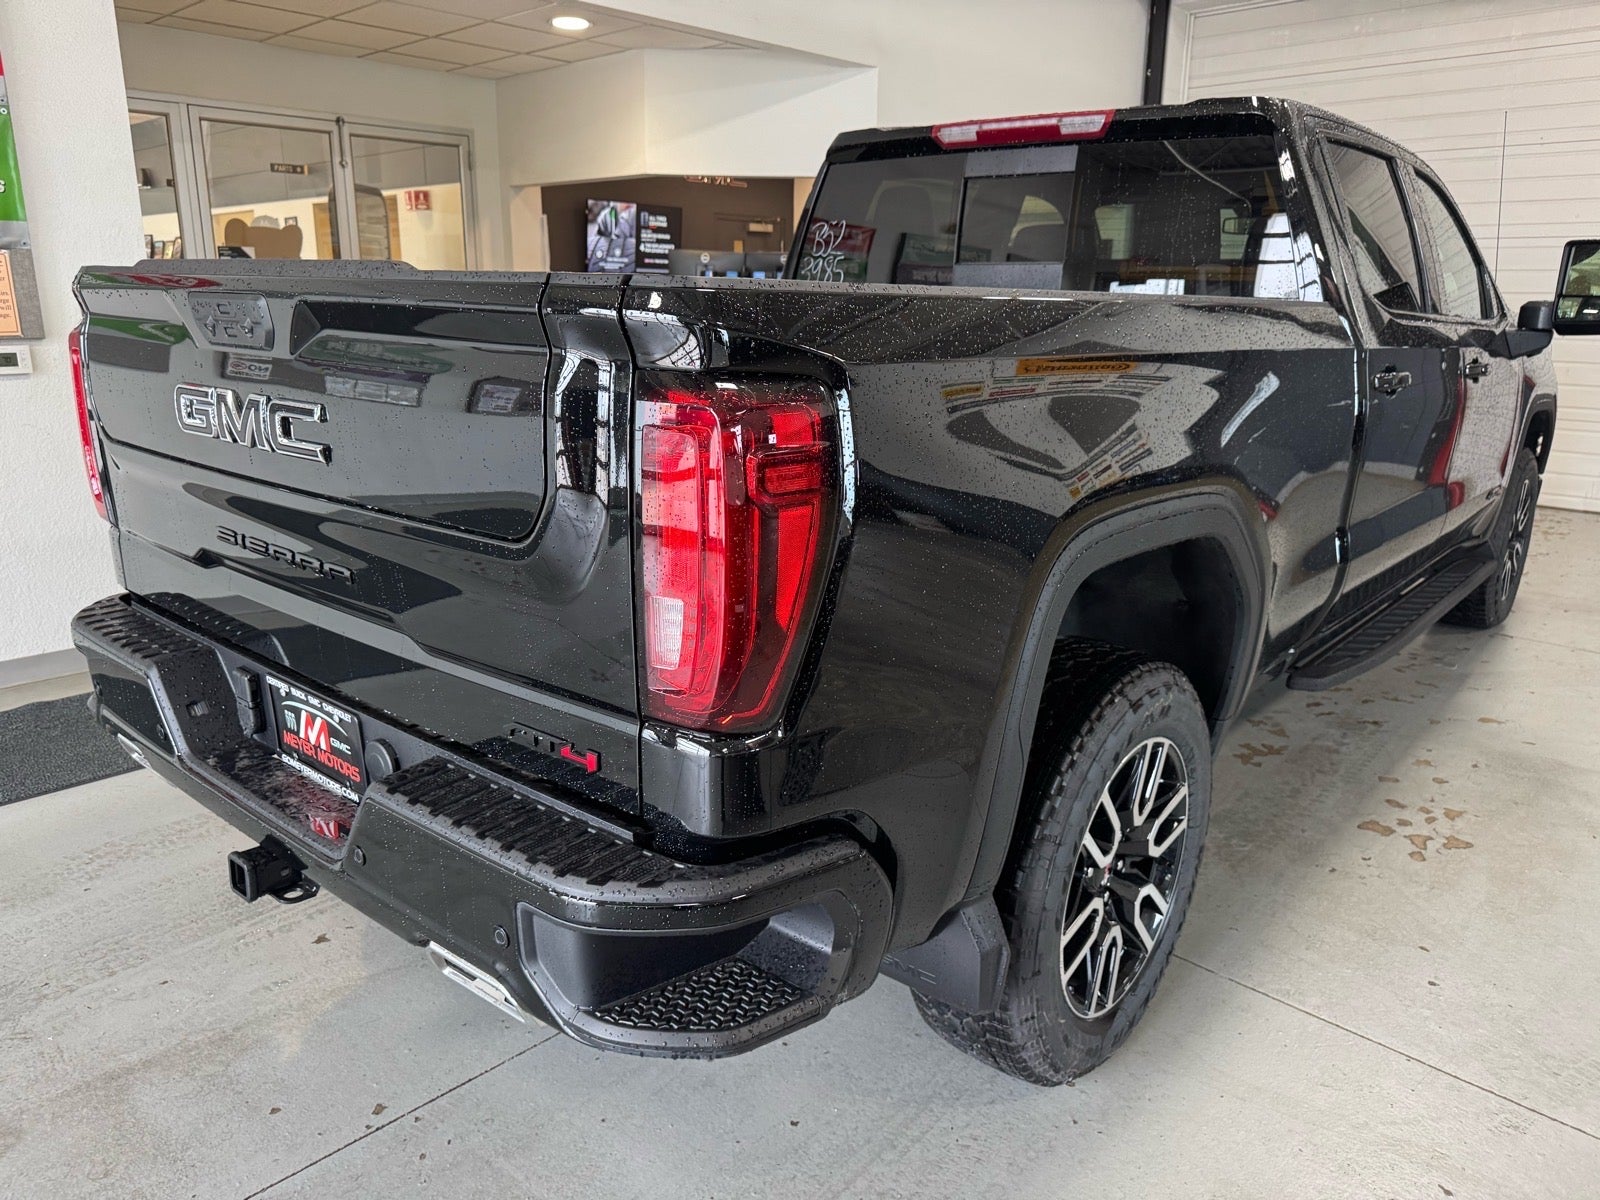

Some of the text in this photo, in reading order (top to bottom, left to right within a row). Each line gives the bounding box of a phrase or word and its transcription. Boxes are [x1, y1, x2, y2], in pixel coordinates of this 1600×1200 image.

[173, 382, 331, 467] GMC
[216, 524, 356, 585] SIERRA
[283, 729, 361, 783] MEYER MOTORS
[329, 736, 352, 756] GMC
